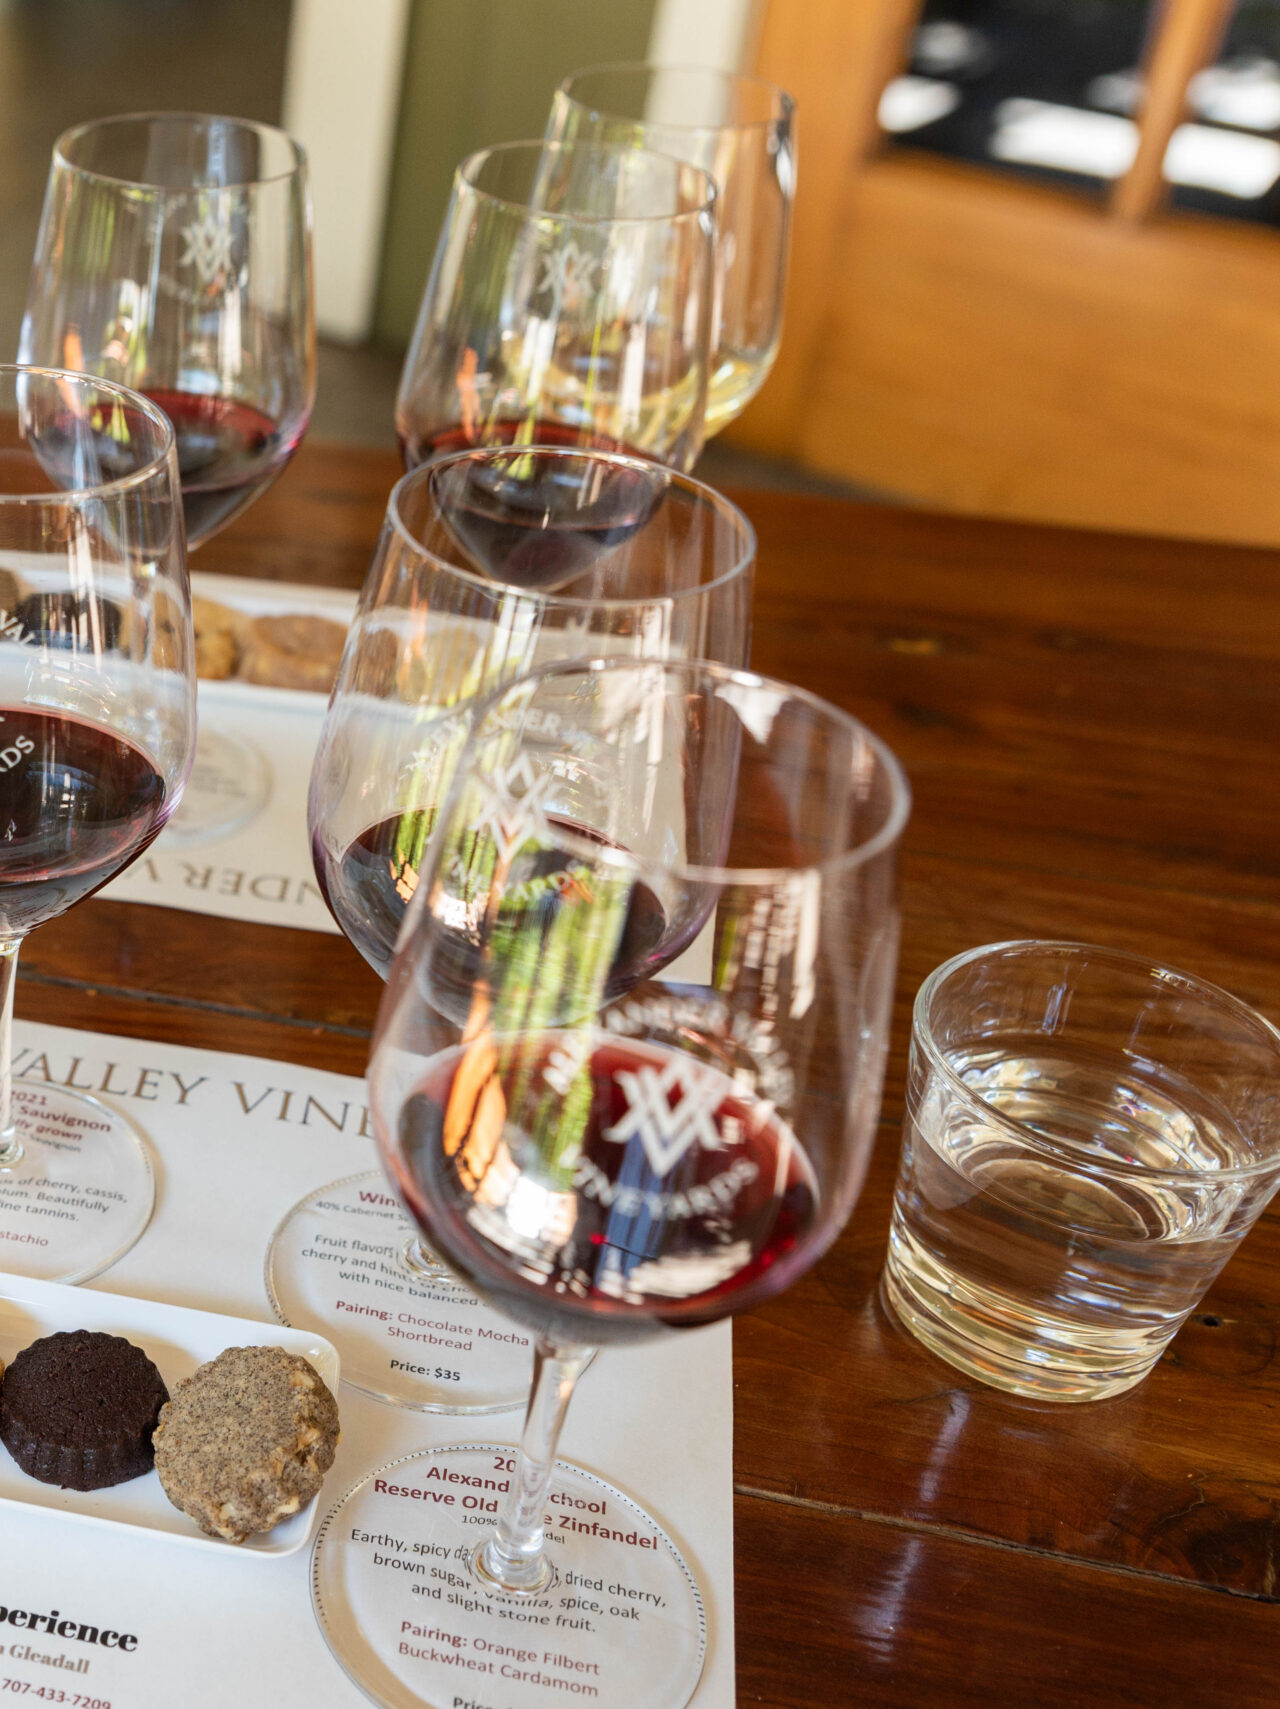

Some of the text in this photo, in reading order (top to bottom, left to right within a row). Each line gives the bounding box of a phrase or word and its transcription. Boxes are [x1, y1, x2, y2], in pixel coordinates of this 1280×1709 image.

[20, 1106, 112, 1133] Sauvignon
[36, 1124, 84, 1142] grown
[36, 1176, 82, 1195] cherry,
[85, 1186, 127, 1204] cassis,
[36, 1190, 110, 1214] Beautifully
[25, 1204, 79, 1222] tannins.
[343, 1204, 395, 1220] Cabernet
[314, 1233, 348, 1250] Fruit
[301, 1247, 348, 1266] cherry
[351, 1257, 377, 1271] and
[339, 1270, 371, 1286] with
[374, 1278, 404, 1293] nice
[408, 1286, 479, 1307] balanced
[335, 1299, 530, 1347] Pairing: Chocolate Mocha
[387, 1326, 473, 1352] Shortbread
[390, 1359, 461, 1382] Price: $35
[426, 1466, 607, 1516] Alexand chool
[374, 1479, 456, 1507] Reserve
[461, 1495, 499, 1514] Old
[559, 1514, 658, 1551] Zinfandel
[461, 1514, 498, 1527] 100%
[351, 1528, 408, 1552] Earthy,
[412, 1542, 451, 1561] spicy
[565, 1570, 604, 1592] dried
[608, 1583, 666, 1608] cherry,
[373, 1552, 426, 1576] brown
[560, 1595, 604, 1616] spice,
[609, 1606, 640, 1621] oak
[411, 1583, 596, 1633] and slight stone fruit.
[9, 1643, 91, 1675] Gleadall
[400, 1620, 600, 1676] Pairing: Orange Filbert
[399, 1641, 599, 1697] Buckwheat Cardamom
[1, 1677, 112, 1709] 707-433-7209
